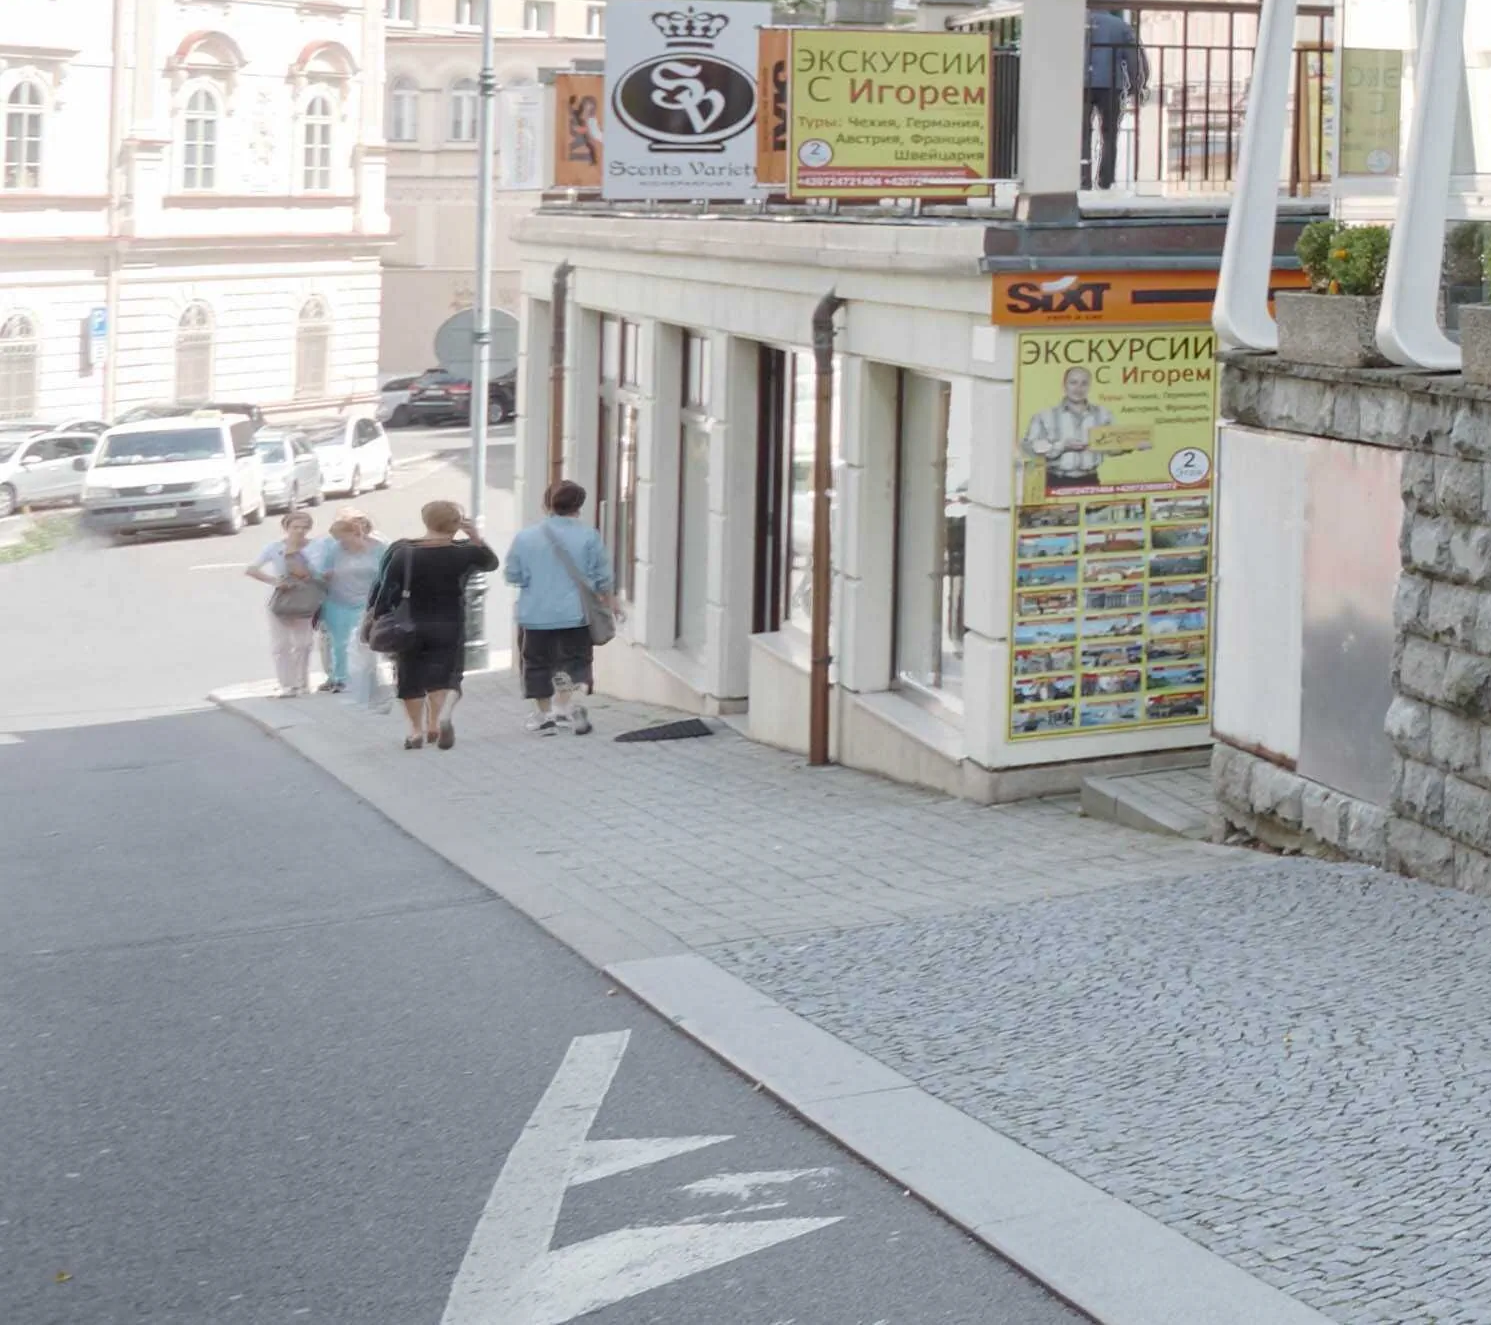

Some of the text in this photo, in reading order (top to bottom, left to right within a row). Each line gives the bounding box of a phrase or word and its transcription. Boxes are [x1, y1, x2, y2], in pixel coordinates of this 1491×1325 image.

[797, 49, 986, 75] ЭКСКУРСИИ
[850, 78, 985, 110] Игорем
[609, 160, 682, 177] Scents
[1022, 336, 1214, 365] ЭКСКУРСИИ
[1122, 366, 1212, 386] Игорем
[1183, 452, 1196, 468] 2
